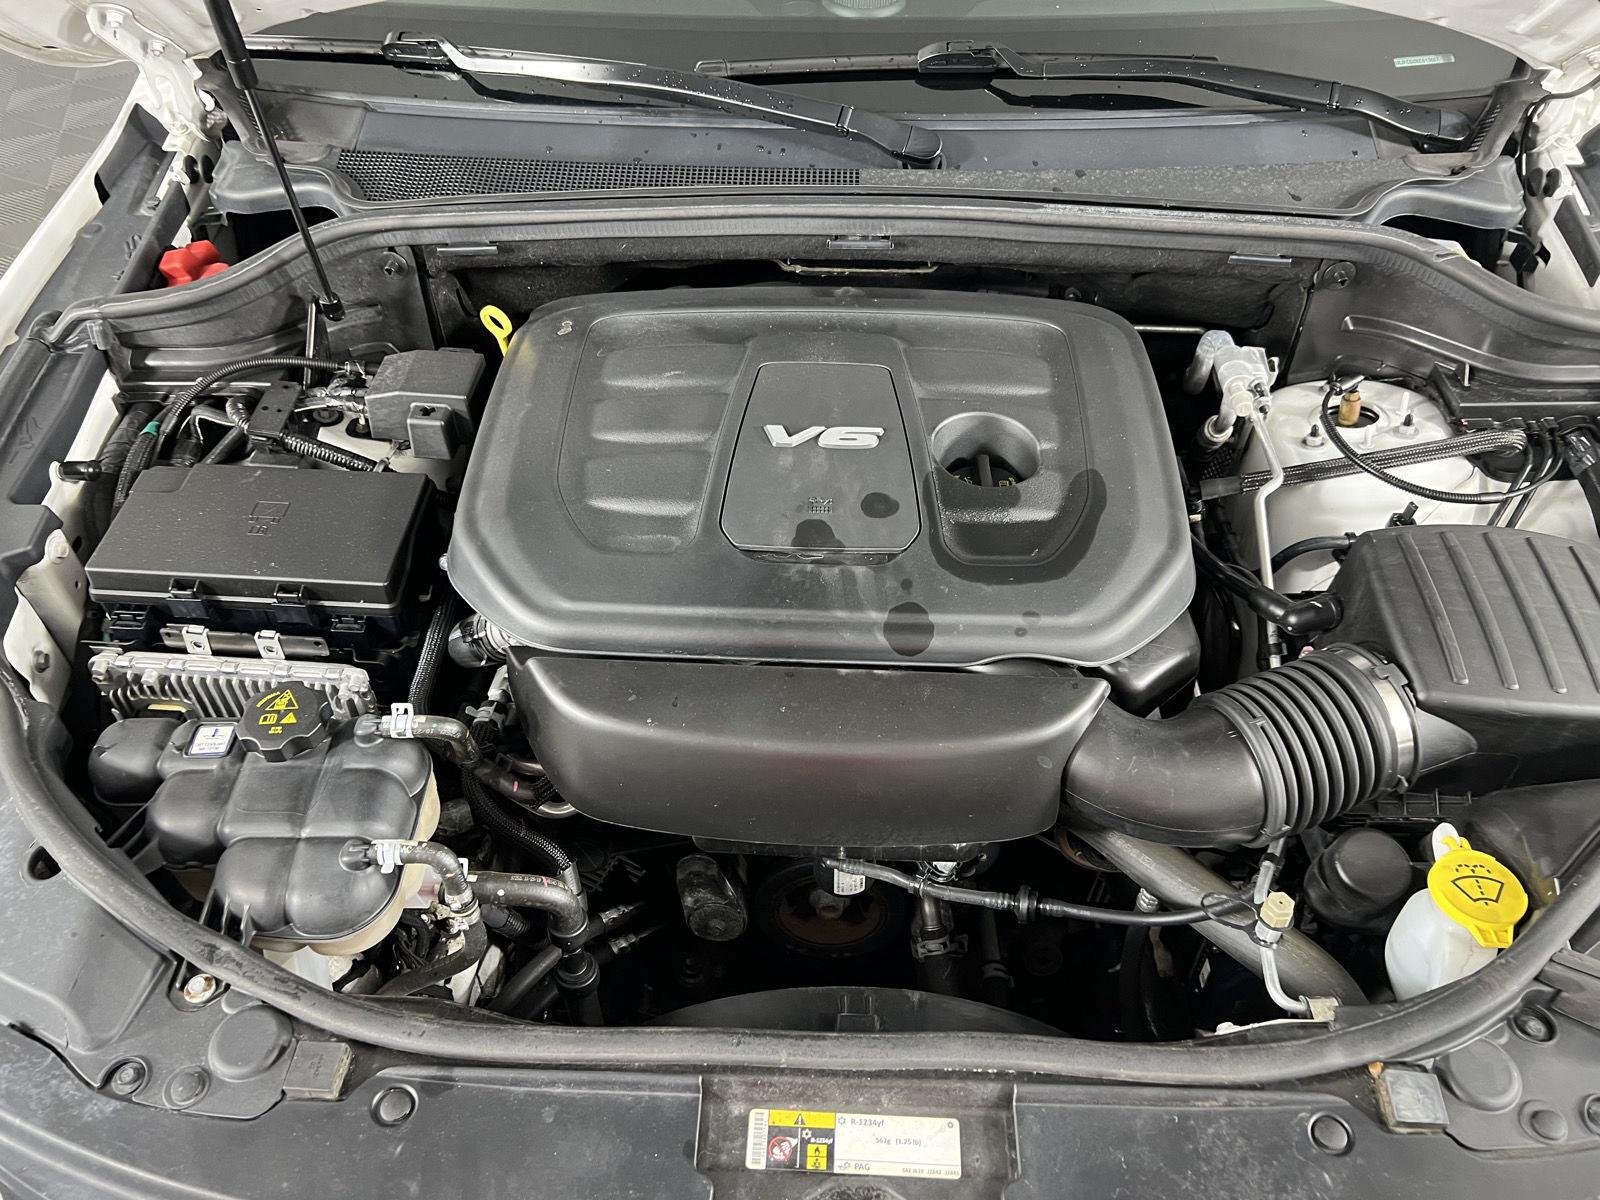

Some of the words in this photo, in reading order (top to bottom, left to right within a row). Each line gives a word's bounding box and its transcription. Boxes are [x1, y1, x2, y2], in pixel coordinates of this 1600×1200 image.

[763, 425, 885, 449] V6
[850, 1117, 885, 1128] R-1234yf
[875, 1136, 892, 1146] 567g
[854, 1162, 871, 1171] PAG
